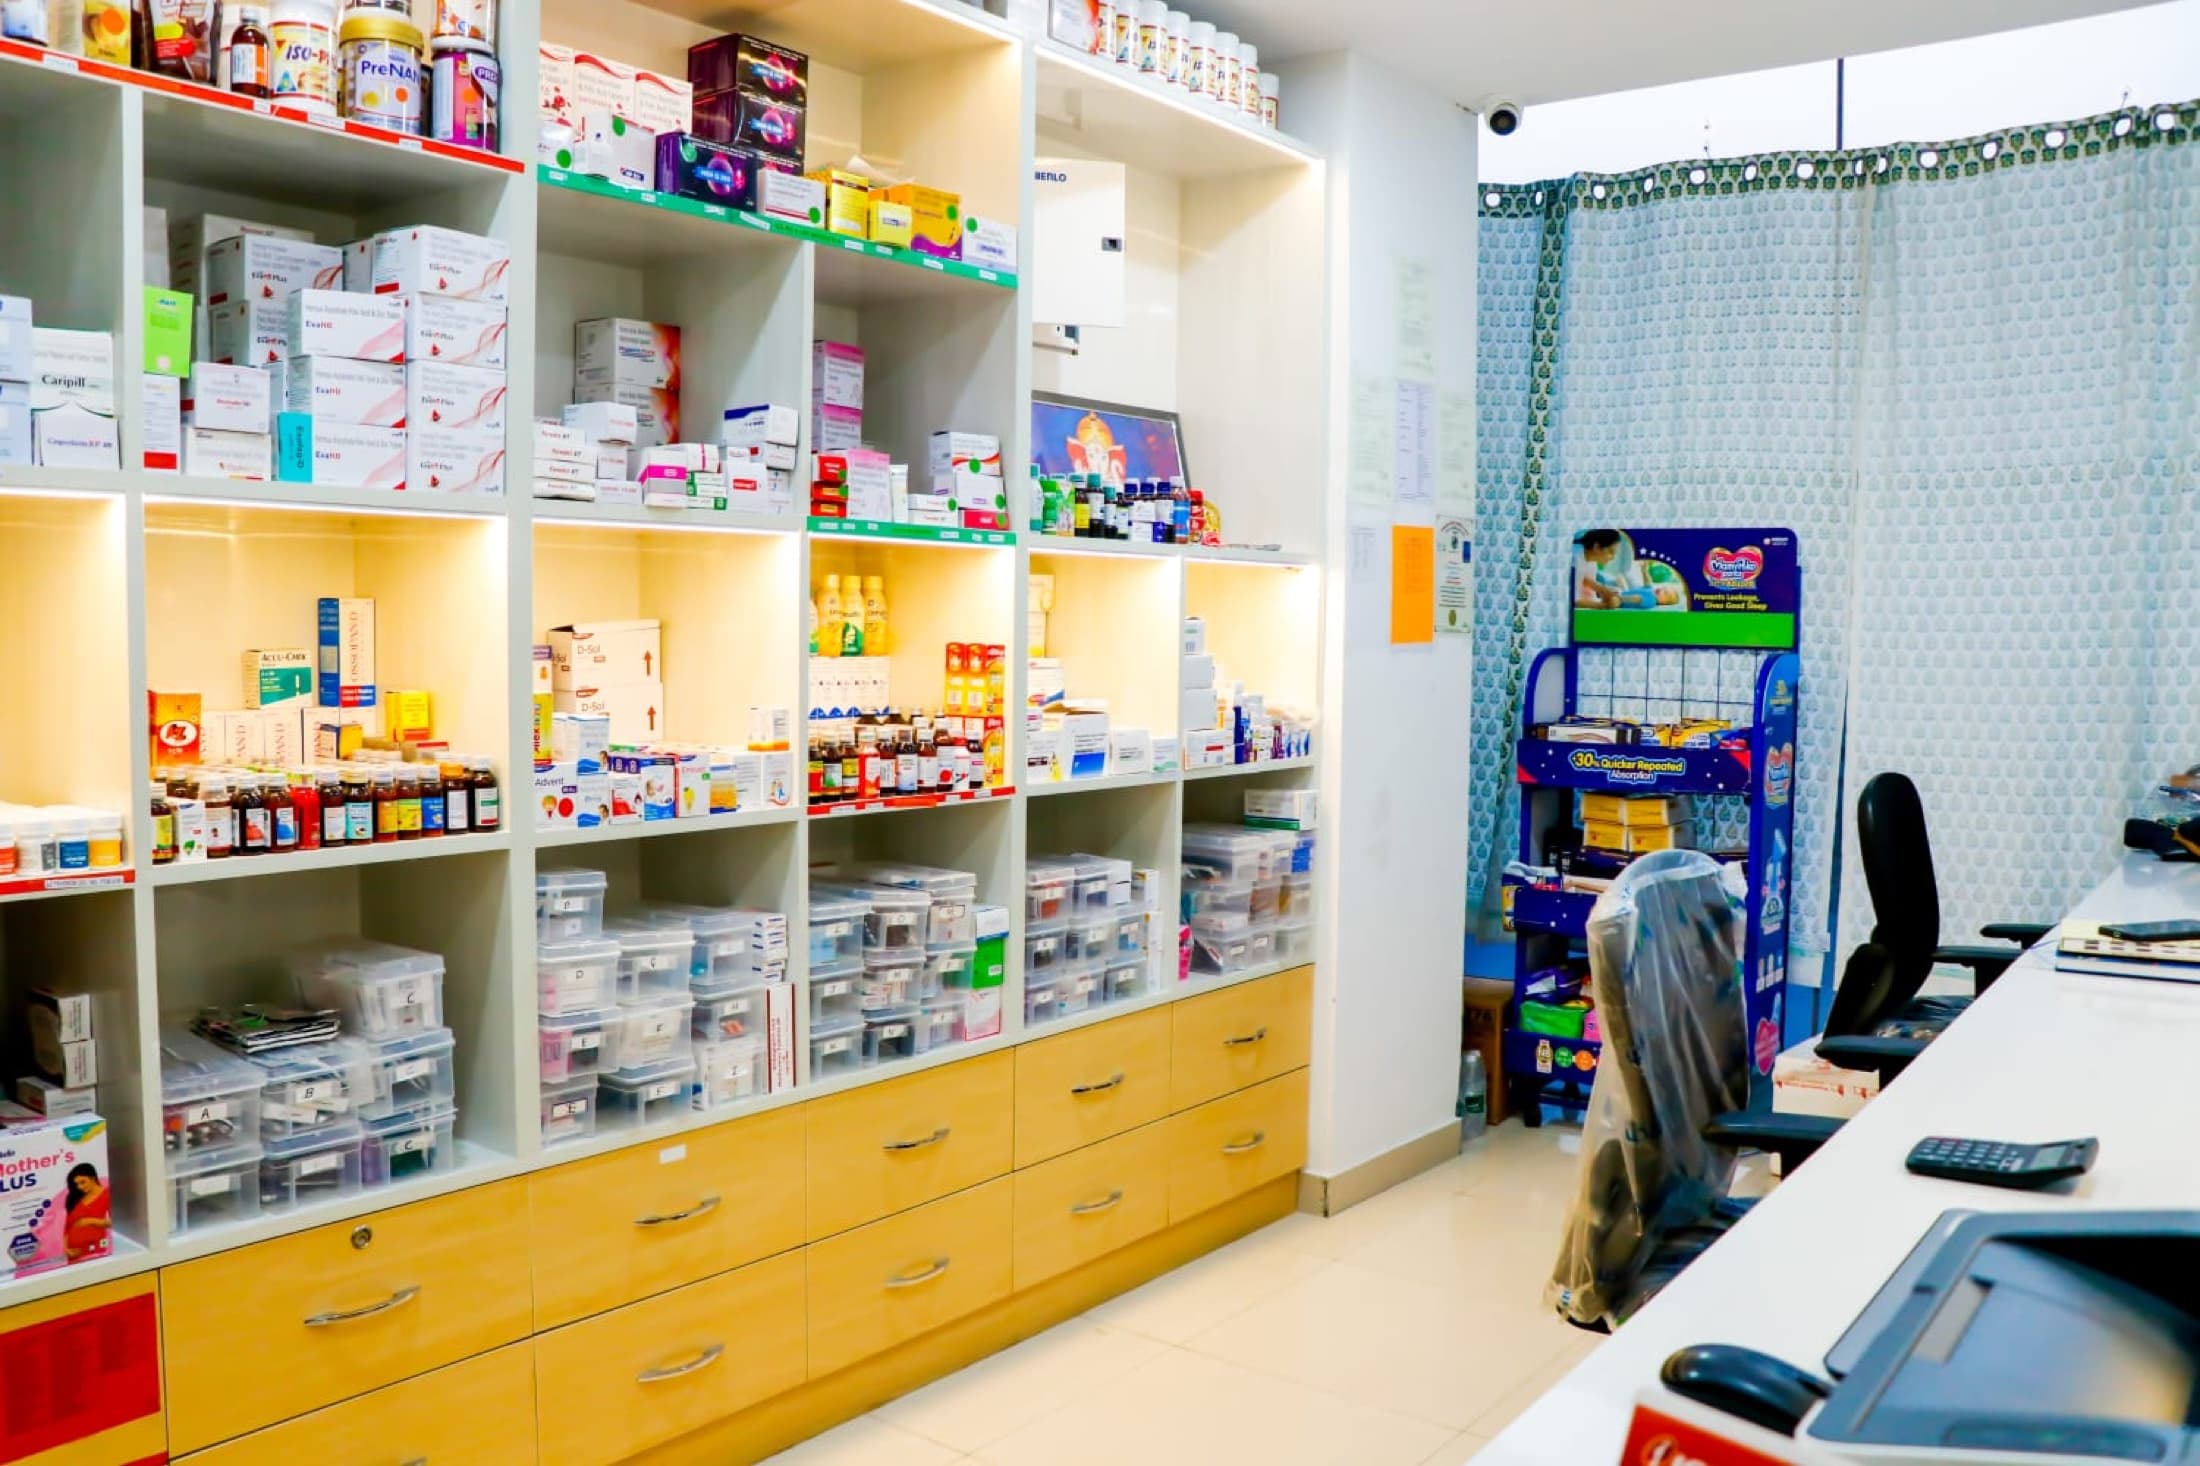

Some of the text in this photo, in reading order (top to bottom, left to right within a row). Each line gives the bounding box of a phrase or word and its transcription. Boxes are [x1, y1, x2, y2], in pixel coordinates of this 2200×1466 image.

[41, 374, 85, 389] Caripill
[1601, 758, 1637, 769] Quicker
[1637, 760, 1683, 772] Repeated
[0, 1148, 76, 1177] other's
[0, 1172, 37, 1193] LUS
